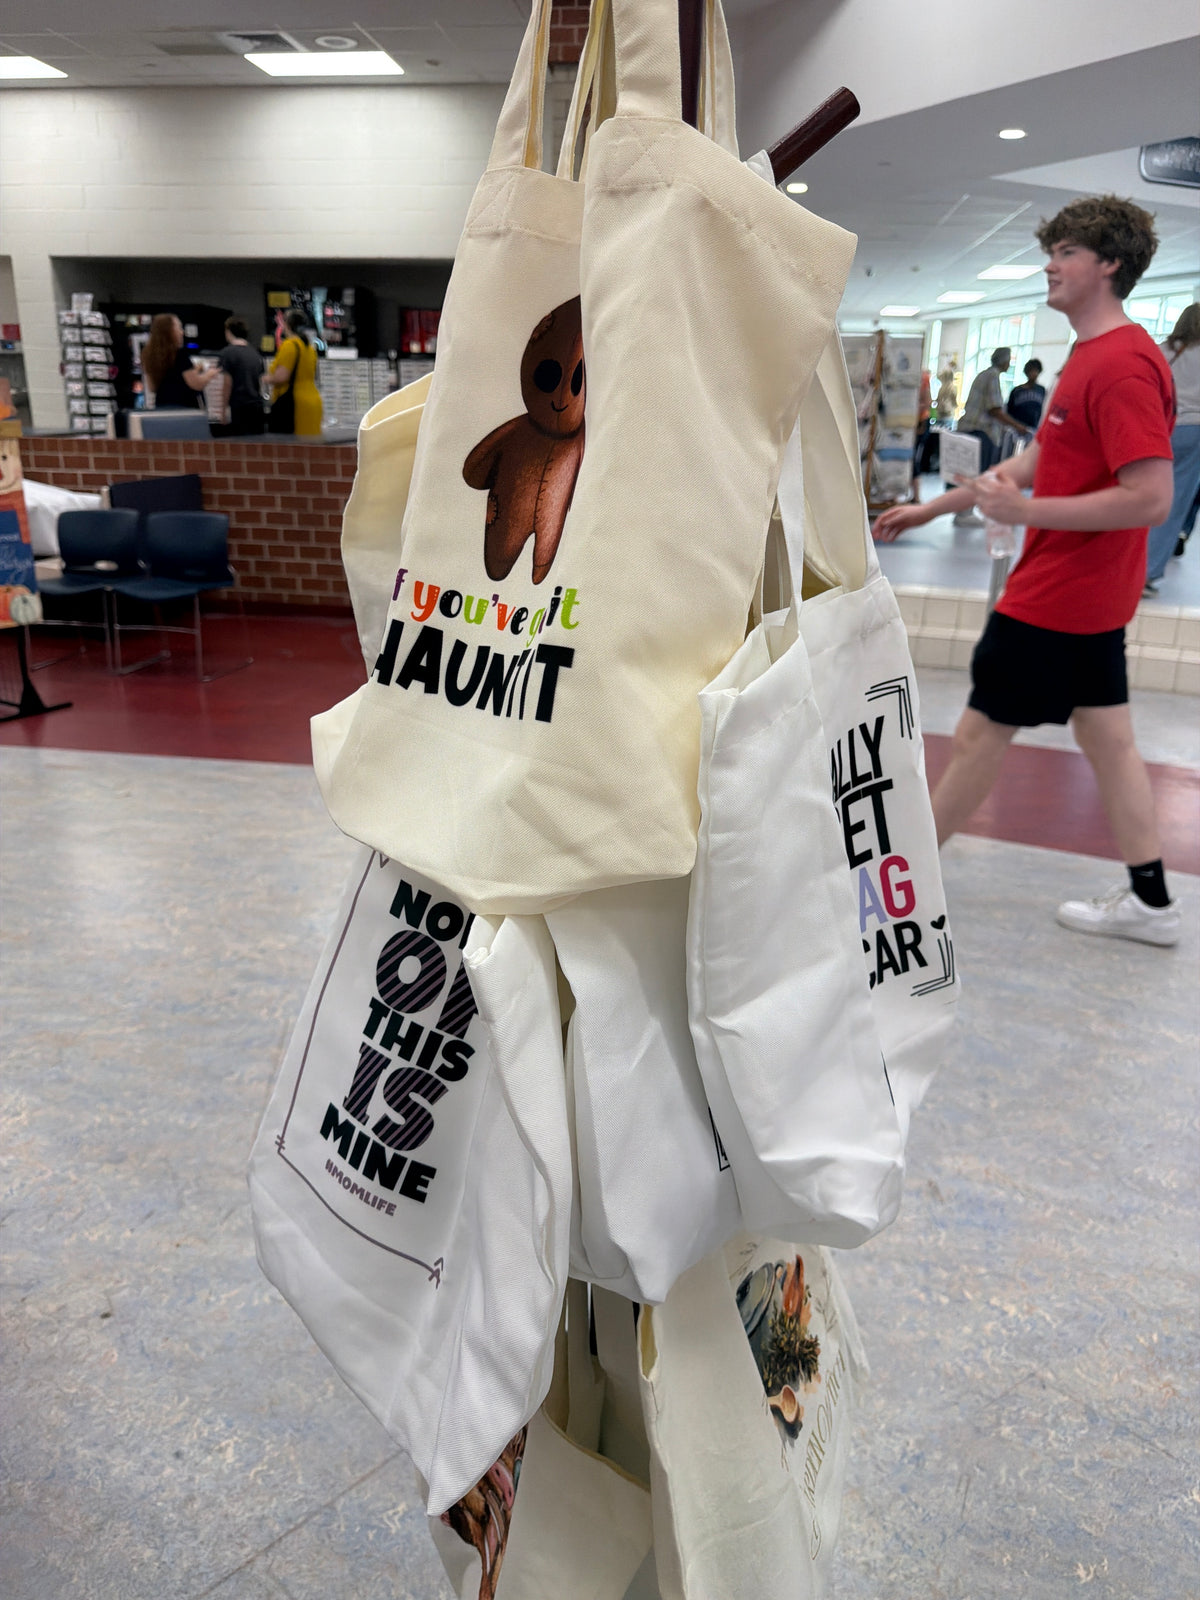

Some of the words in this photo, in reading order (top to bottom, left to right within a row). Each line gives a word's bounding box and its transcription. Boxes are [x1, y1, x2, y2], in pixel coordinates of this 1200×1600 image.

[410, 580, 529, 635] you've
[834, 778, 894, 870] ET
[389, 879, 477, 950] NO
[858, 855, 916, 934] AG
[363, 996, 475, 1082] THIS
[342, 1041, 449, 1152] IS
[320, 1101, 437, 1204] MINE
[325, 1158, 397, 1217] #MOMLIFE
